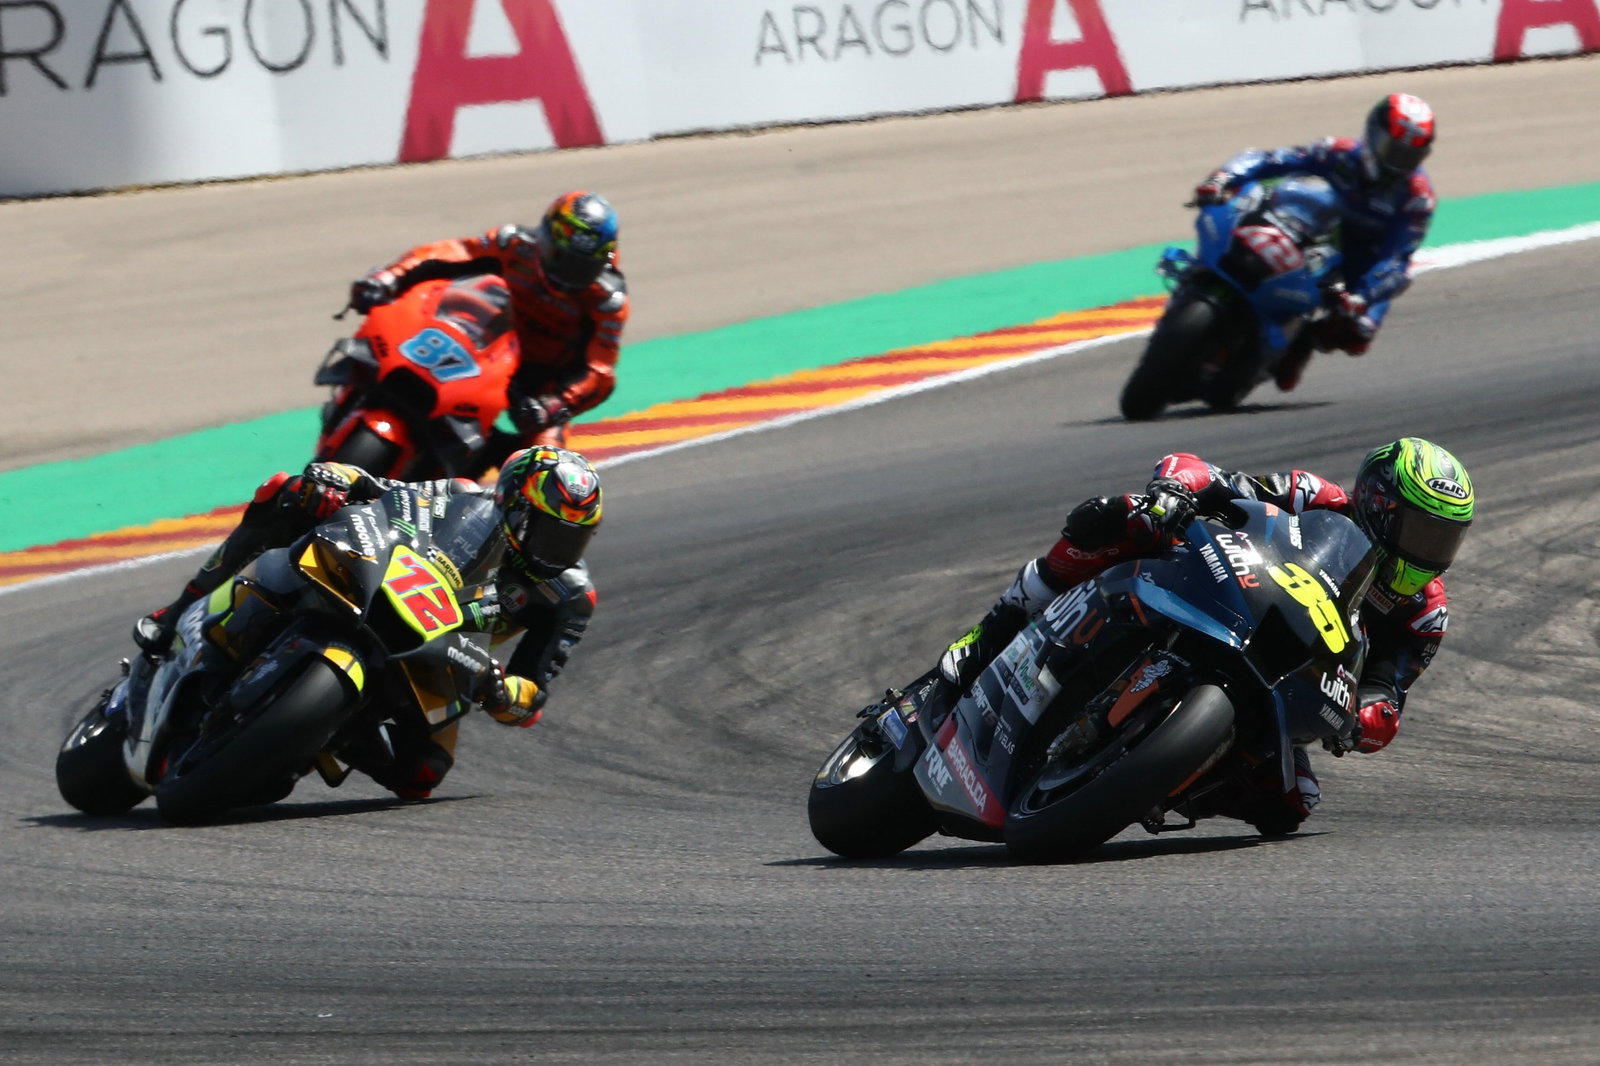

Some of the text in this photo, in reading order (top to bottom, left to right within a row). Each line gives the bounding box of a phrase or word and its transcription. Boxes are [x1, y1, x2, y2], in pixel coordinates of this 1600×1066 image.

[754, 0, 1133, 103] ARAGON A
[398, 327, 481, 383] 87
[1432, 480, 1464, 497] HJC
[436, 556, 462, 586] BARDAHL
[1199, 542, 1229, 584] YAMAHA
[1318, 568, 1341, 598] YAMAHA
[1267, 562, 1350, 654] 35
[1318, 703, 1345, 731] YAMAHA
[925, 742, 953, 789] RNF
[947, 737, 987, 813] BARRACUDA
